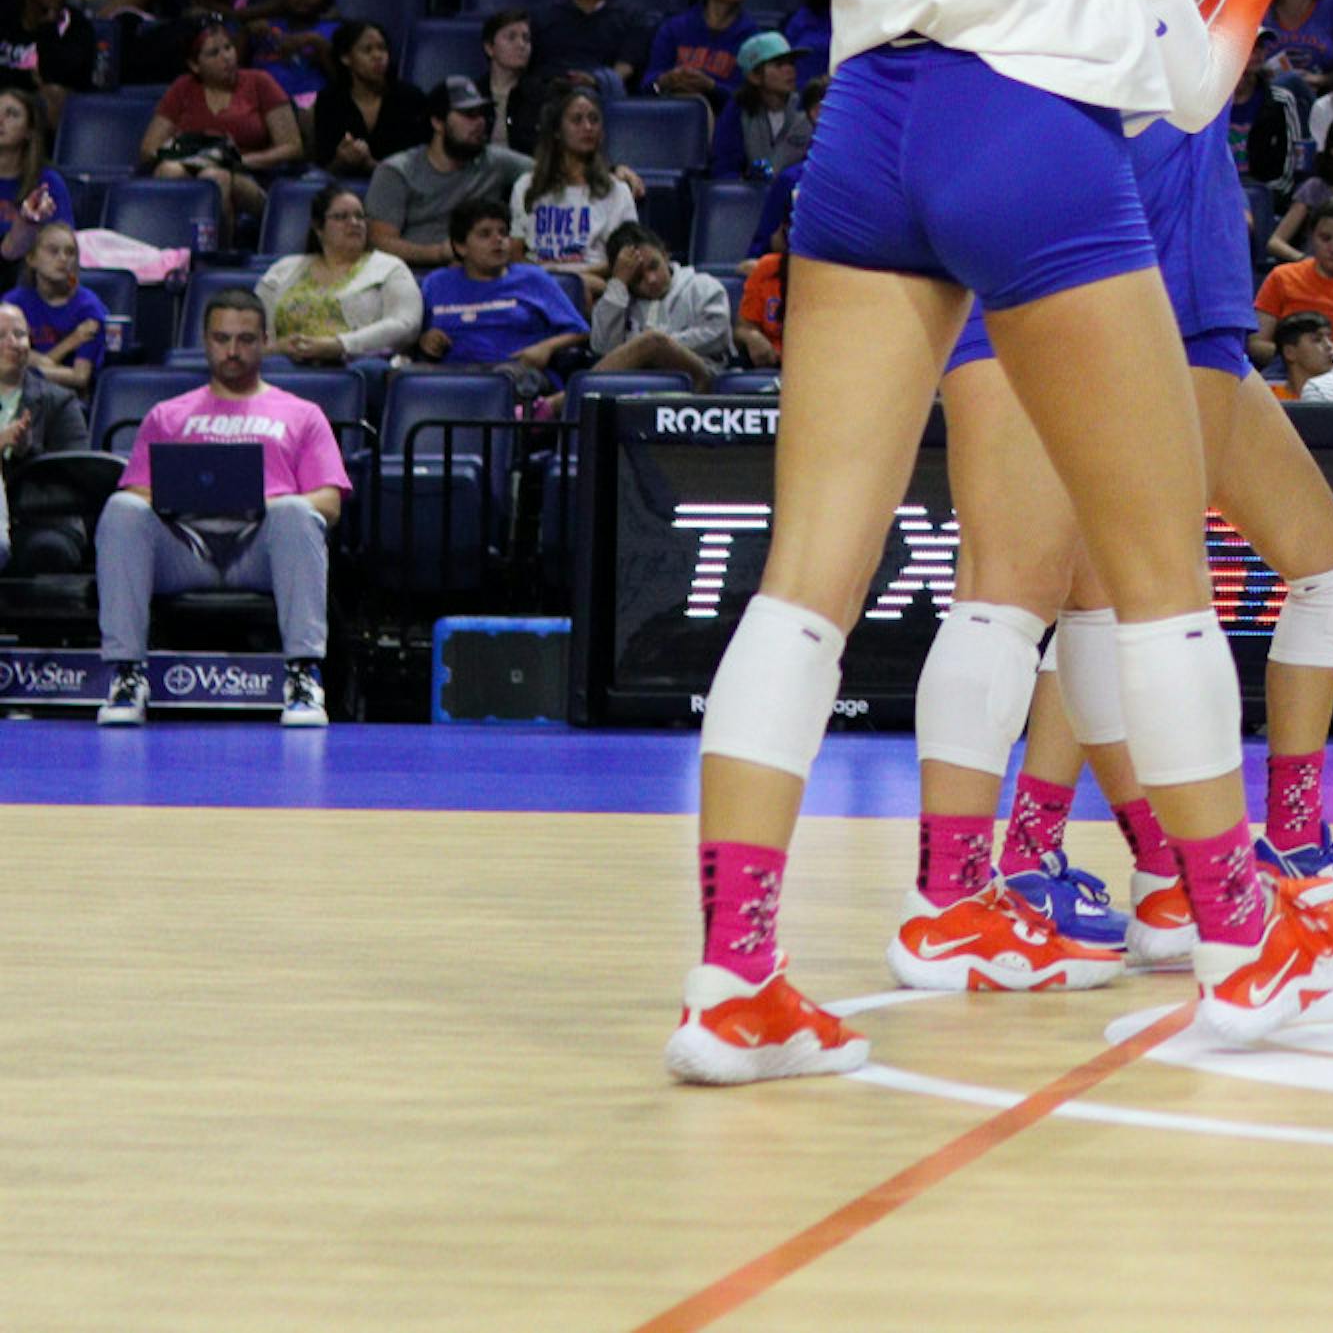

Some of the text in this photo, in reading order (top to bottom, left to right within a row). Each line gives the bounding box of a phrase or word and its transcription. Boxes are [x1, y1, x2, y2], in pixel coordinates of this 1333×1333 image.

[183, 414, 286, 441] FLORIDA
[657, 407, 780, 434] ROCKET
[14, 661, 88, 690] VyStar
[196, 665, 272, 695] VyStar
